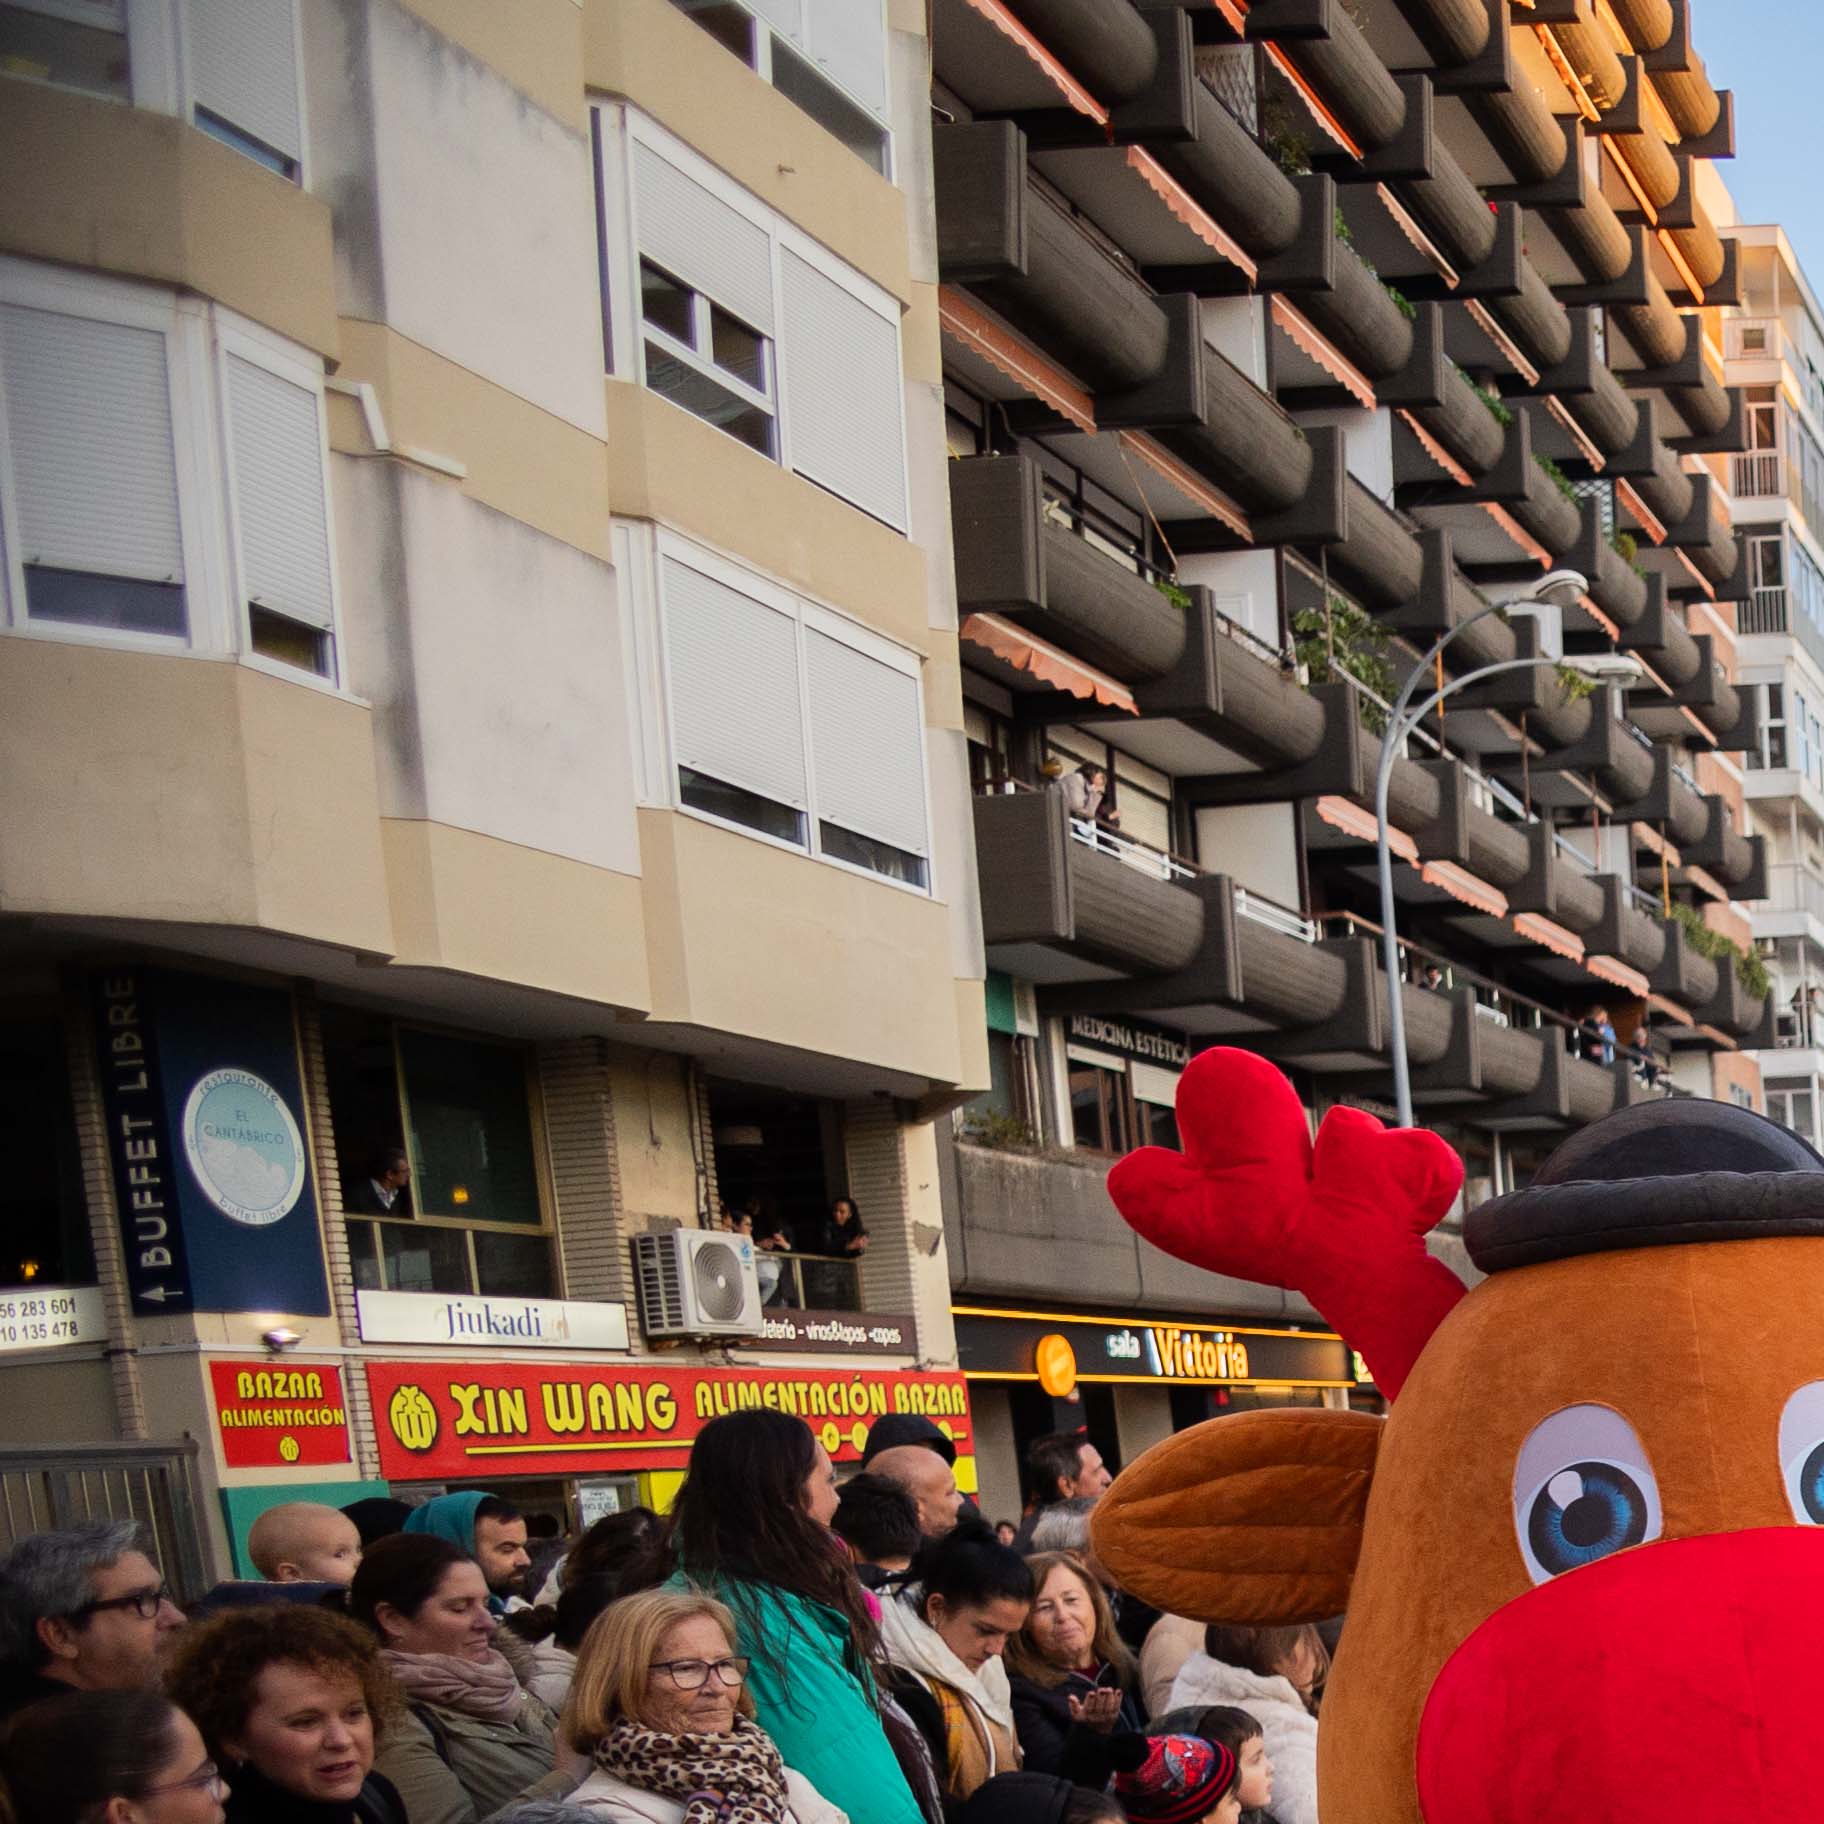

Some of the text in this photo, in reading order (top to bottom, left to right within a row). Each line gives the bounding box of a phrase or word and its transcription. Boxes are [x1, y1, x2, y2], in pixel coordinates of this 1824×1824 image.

[1071, 1015, 1136, 1051] MEDICINA
[105, 976, 172, 1268] BUFFET LIBRE
[235, 1110, 249, 1122] EL
[20, 1300, 46, 1317] 283
[51, 1297, 76, 1314] 601
[446, 1301, 542, 1338] Jiukadi
[22, 1323, 47, 1340] 135
[52, 1320, 78, 1337] 478
[1106, 1327, 1248, 1378] sala Victoria
[237, 1371, 323, 1399] BAZAR
[221, 1403, 345, 1428] ALIMENTACIÓN
[450, 1376, 966, 1435] XIN WANG ALIMENTACIÓN BAZAR
